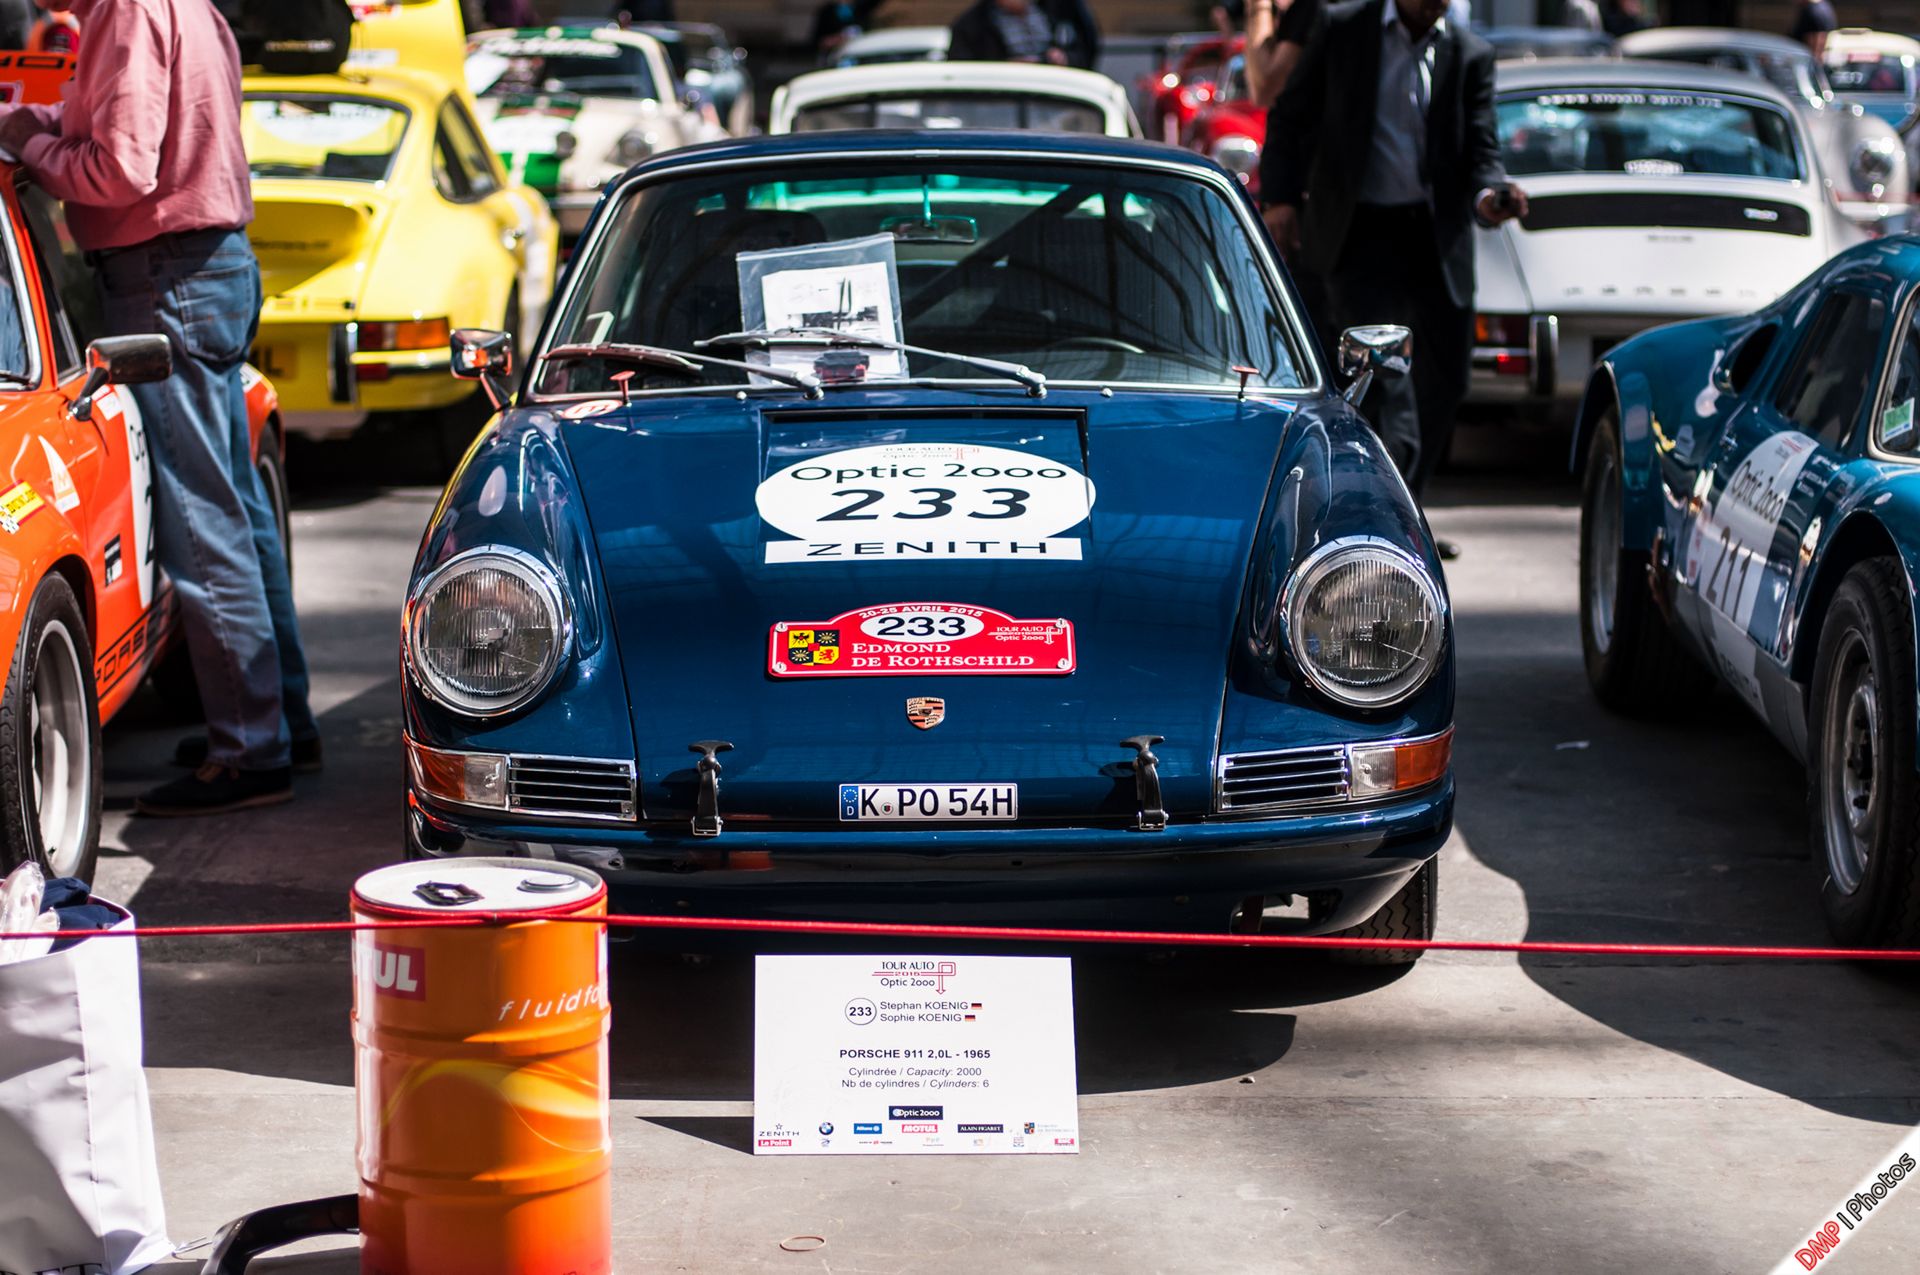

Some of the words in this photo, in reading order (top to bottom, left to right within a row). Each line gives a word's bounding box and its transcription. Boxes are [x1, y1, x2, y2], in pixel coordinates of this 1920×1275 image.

[791, 464, 926, 484] Optic
[944, 463, 1067, 478] 2000
[816, 487, 1030, 522] 233
[806, 541, 1047, 556] ZENITH
[1706, 526, 1754, 622] 211
[859, 606, 898, 619] 20-25
[902, 605, 945, 613] AVRIL
[950, 606, 984, 617] 2015
[877, 616, 966, 637] 233
[851, 643, 951, 653] EDMOND
[851, 657, 881, 667] DE
[888, 655, 1034, 667] ROTHSCHILD
[861, 788, 880, 817] K
[897, 788, 939, 817] PO
[949, 788, 1012, 817] 54H
[846, 806, 855, 816] D
[352, 943, 418, 992] TUL
[882, 961, 907, 970] TOUR
[909, 961, 935, 970] AUTO
[880, 978, 907, 988] Optic
[910, 978, 936, 987] 2000
[499, 985, 602, 1021] fluidfo
[880, 1001, 921, 1012] Stephan
[924, 1001, 968, 1010] KOENIG
[849, 1006, 872, 1016] 233
[880, 1013, 915, 1023] Sophie
[918, 1013, 962, 1022] KOENIG
[839, 1049, 900, 1058] PORSCHE
[904, 1049, 923, 1058] 911
[927, 1049, 952, 1060] 2,0L
[963, 1049, 991, 1058] 1965
[848, 1067, 897, 1078] Cylindrée
[906, 1067, 953, 1078] Capacity:
[956, 1067, 982, 1076] 2000
[841, 1079, 857, 1088] Nb
[859, 1079, 872, 1088] de
[875, 1079, 920, 1090] cylindres
[929, 1079, 979, 1090] Cylinders:
[982, 1079, 990, 1088] 6
